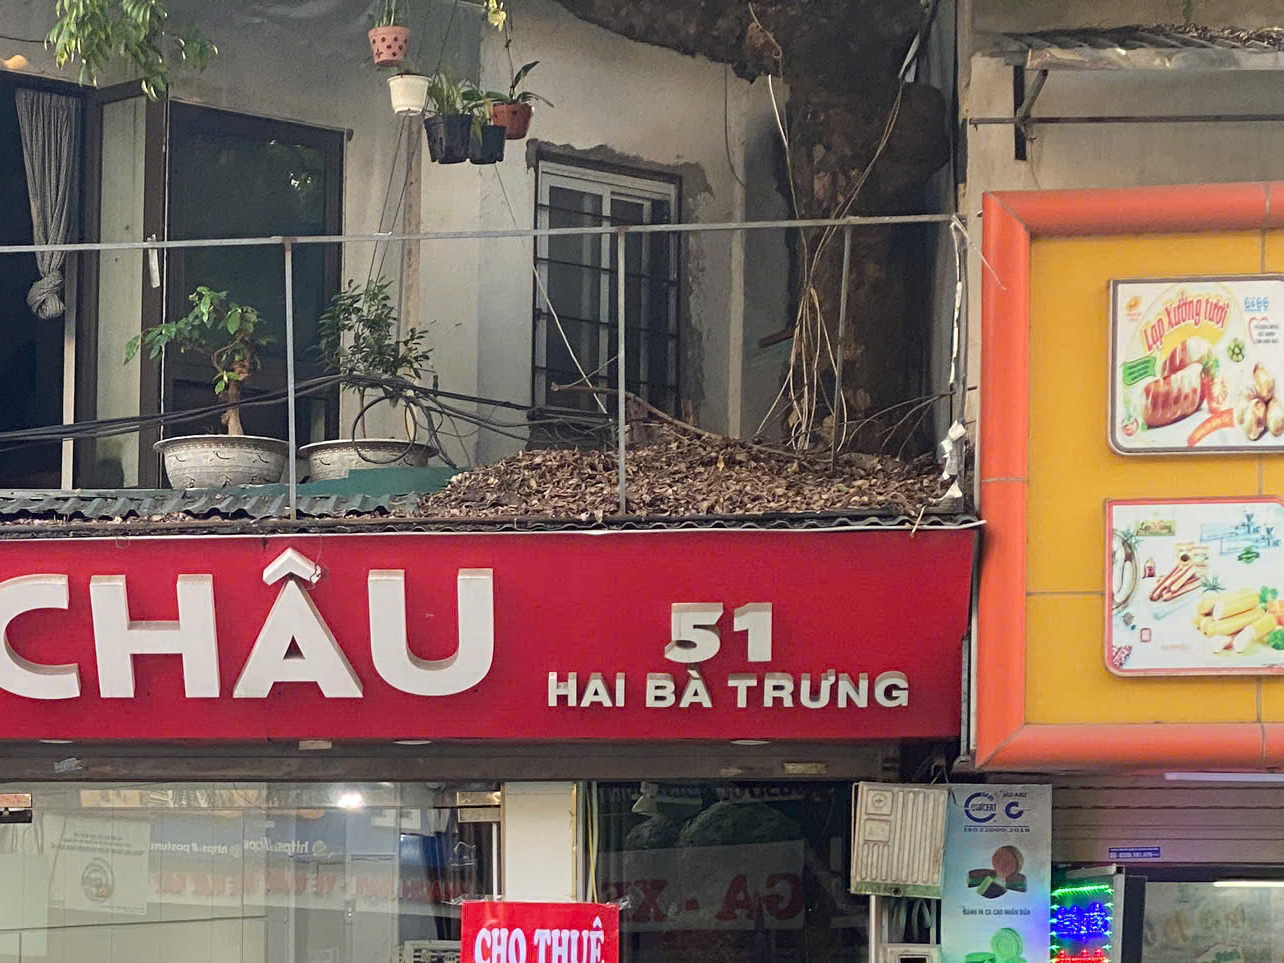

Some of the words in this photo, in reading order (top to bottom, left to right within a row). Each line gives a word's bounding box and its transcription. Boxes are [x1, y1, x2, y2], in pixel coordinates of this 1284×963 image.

[664, 601, 773, 664] 51
[547, 672, 625, 708] HAI
[645, 667, 713, 708] BÀ
[727, 668, 910, 709] TRƯNG
